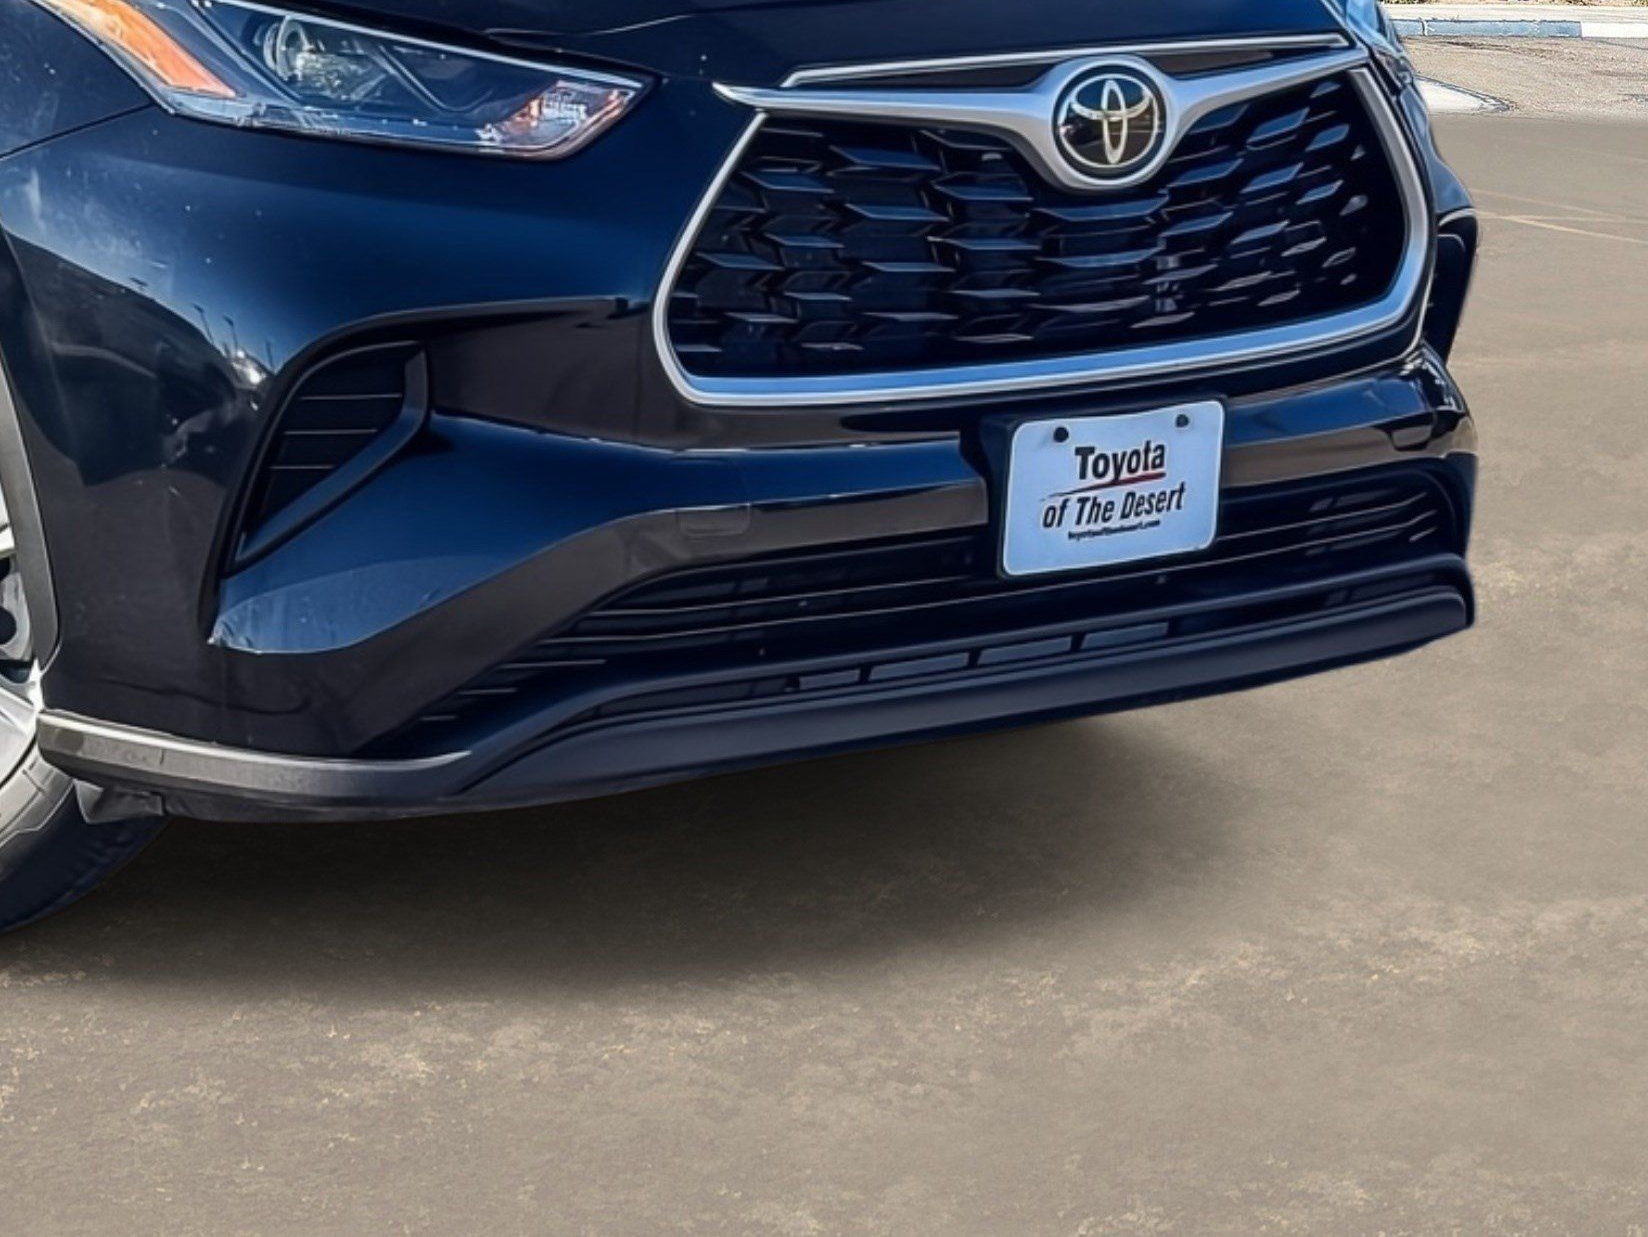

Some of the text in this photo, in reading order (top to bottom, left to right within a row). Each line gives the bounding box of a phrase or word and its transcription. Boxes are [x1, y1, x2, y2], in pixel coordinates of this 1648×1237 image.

[1074, 440, 1166, 483] Toyota
[1042, 481, 1186, 528] of The Desert
